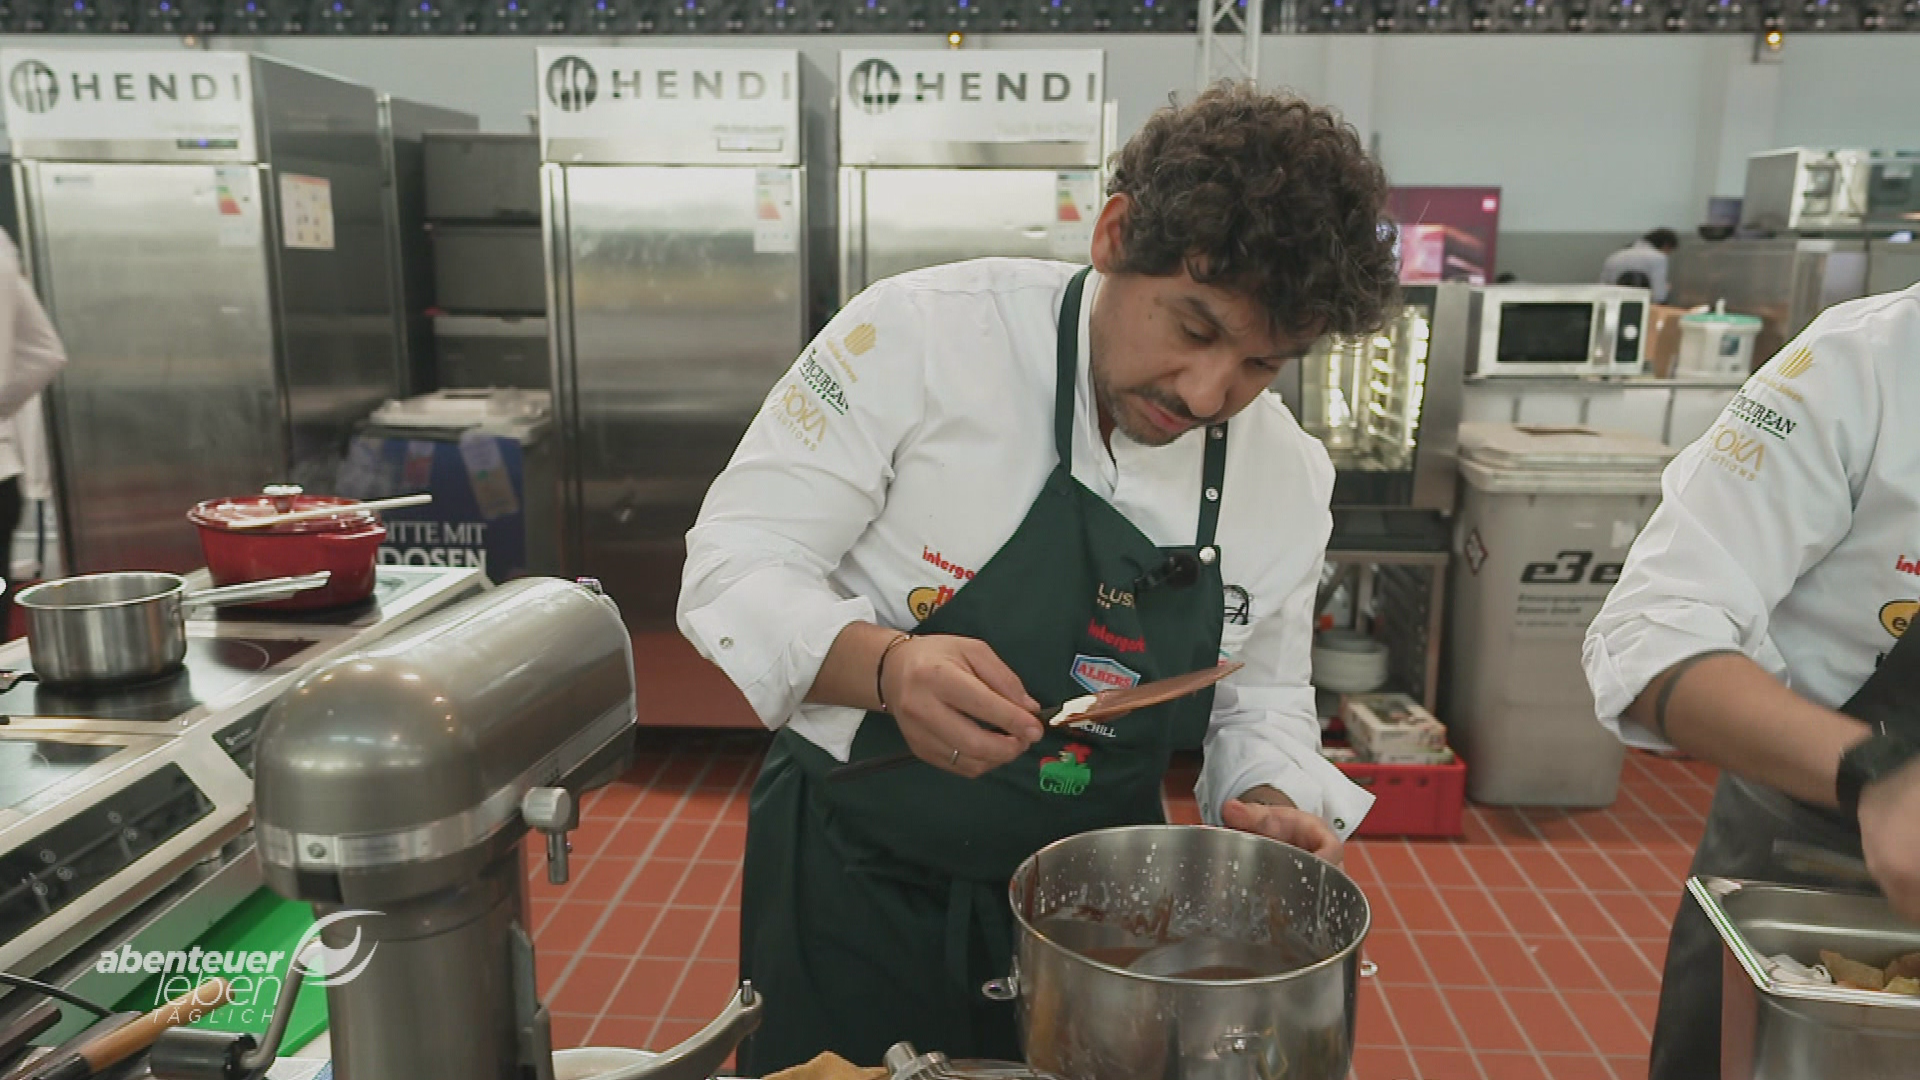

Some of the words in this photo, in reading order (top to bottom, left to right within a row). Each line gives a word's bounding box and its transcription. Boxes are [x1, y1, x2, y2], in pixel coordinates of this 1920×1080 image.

[71, 72, 241, 101] HENDI
[612, 70, 791, 100] HENDI
[915, 72, 1096, 102] HENDI
[384, 521, 440, 544] ITTE
[443, 522, 488, 545] MIT
[377, 546, 488, 568] DOSEN
[1076, 663, 1133, 689] ALBERS
[1040, 775, 1086, 796] Gallo
